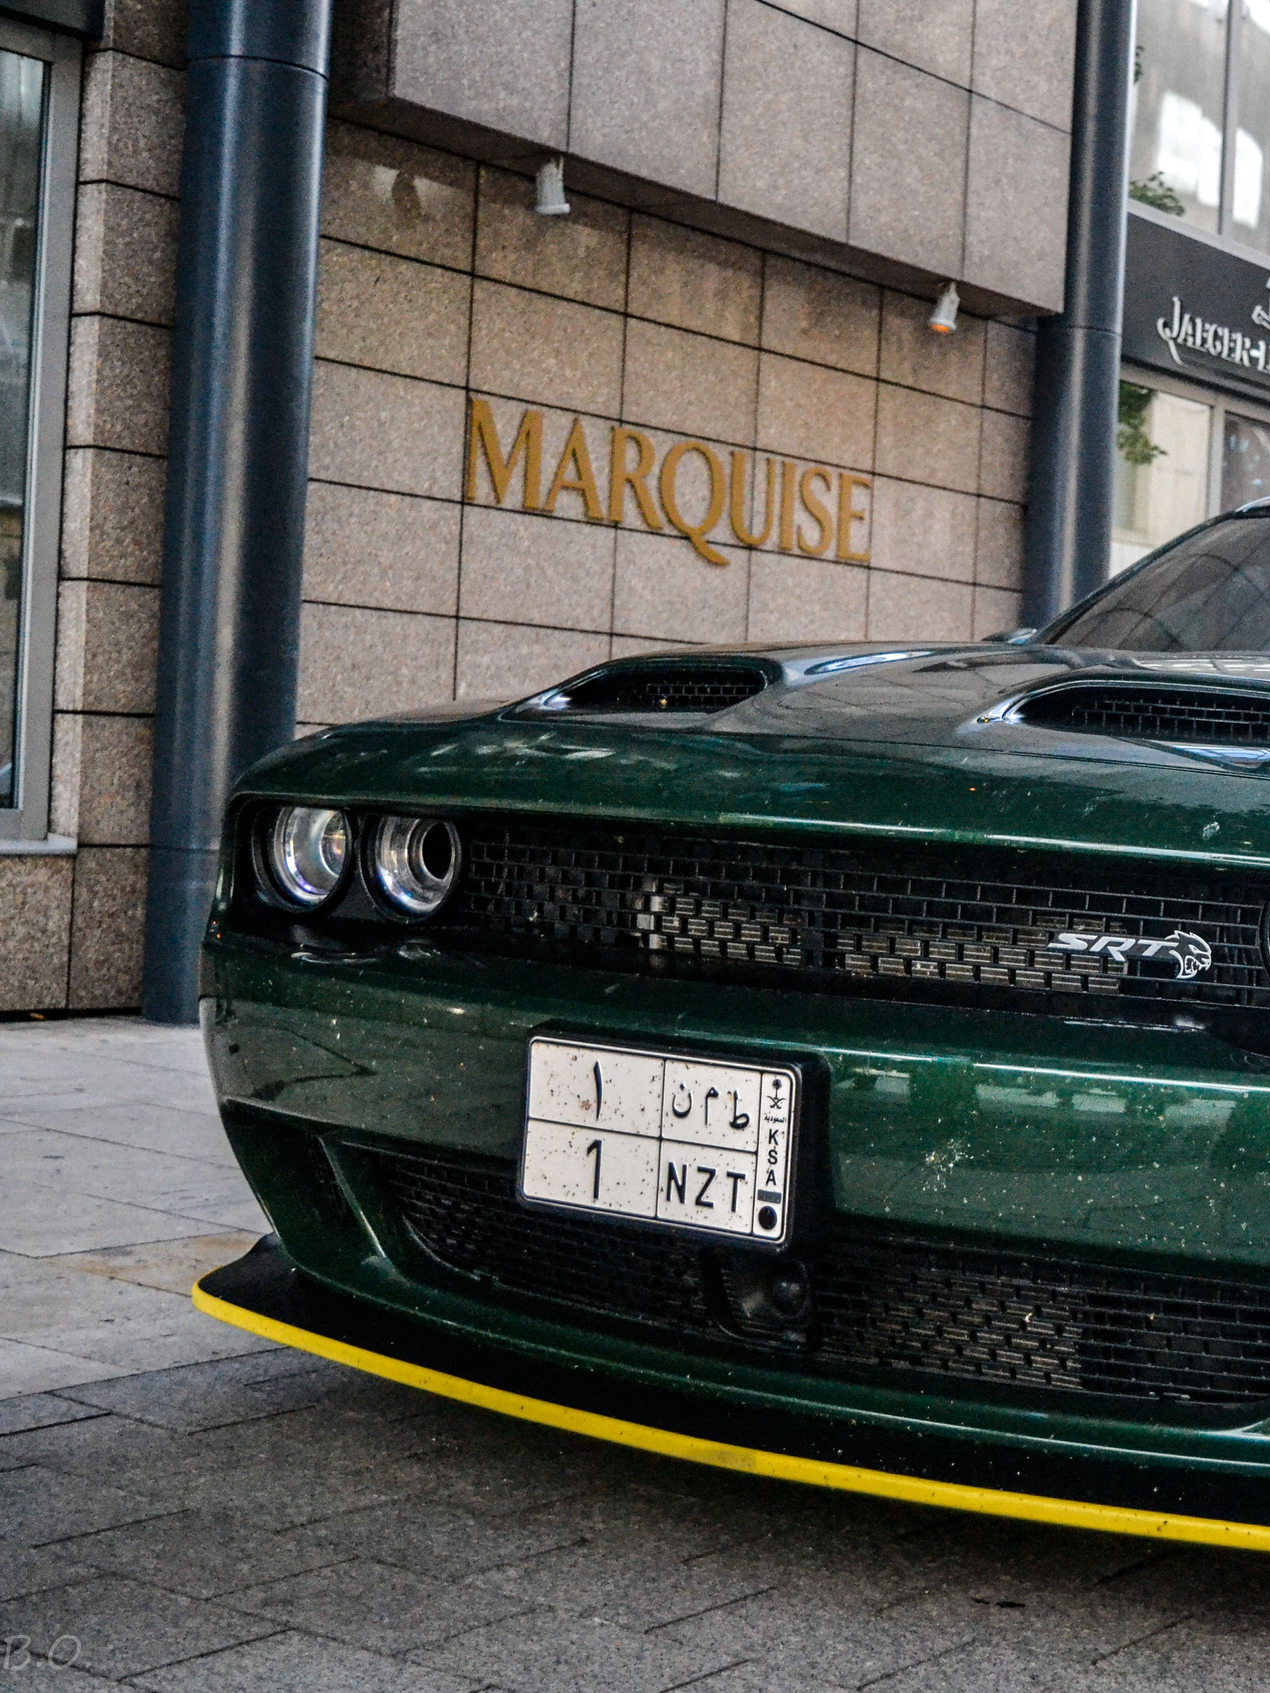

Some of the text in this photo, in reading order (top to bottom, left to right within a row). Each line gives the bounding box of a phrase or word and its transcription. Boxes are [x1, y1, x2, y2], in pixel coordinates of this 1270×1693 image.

[466, 398, 873, 566] MARQUISE
[1048, 932, 1180, 963] SRT
[587, 1139, 602, 1200] 1
[666, 1161, 746, 1213] NZT
